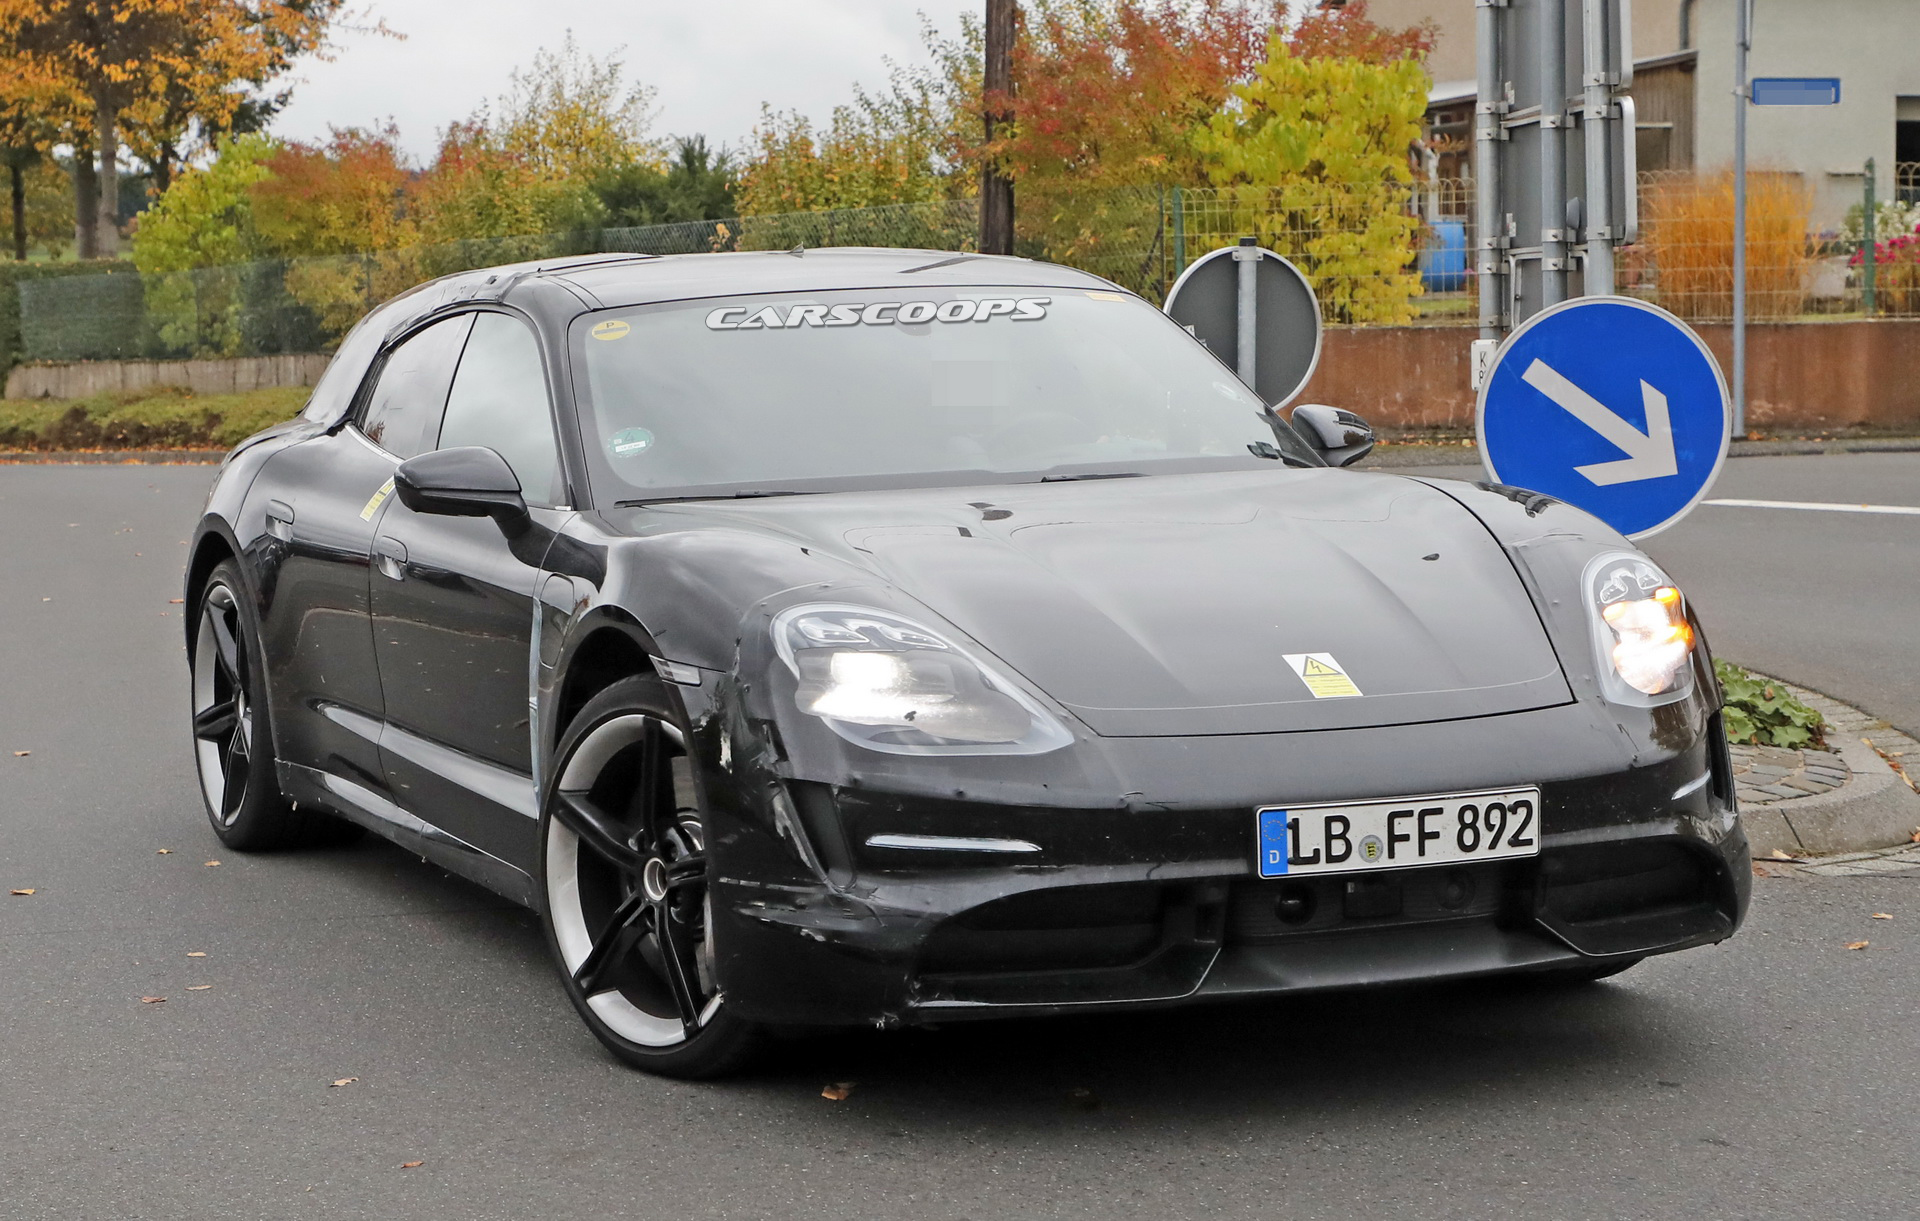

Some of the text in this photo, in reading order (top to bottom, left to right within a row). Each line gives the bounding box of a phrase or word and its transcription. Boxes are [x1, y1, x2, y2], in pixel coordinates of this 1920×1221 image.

[1479, 351, 1487, 367] K
[1288, 799, 1534, 866] LB FF 892
[1269, 850, 1280, 864] D
